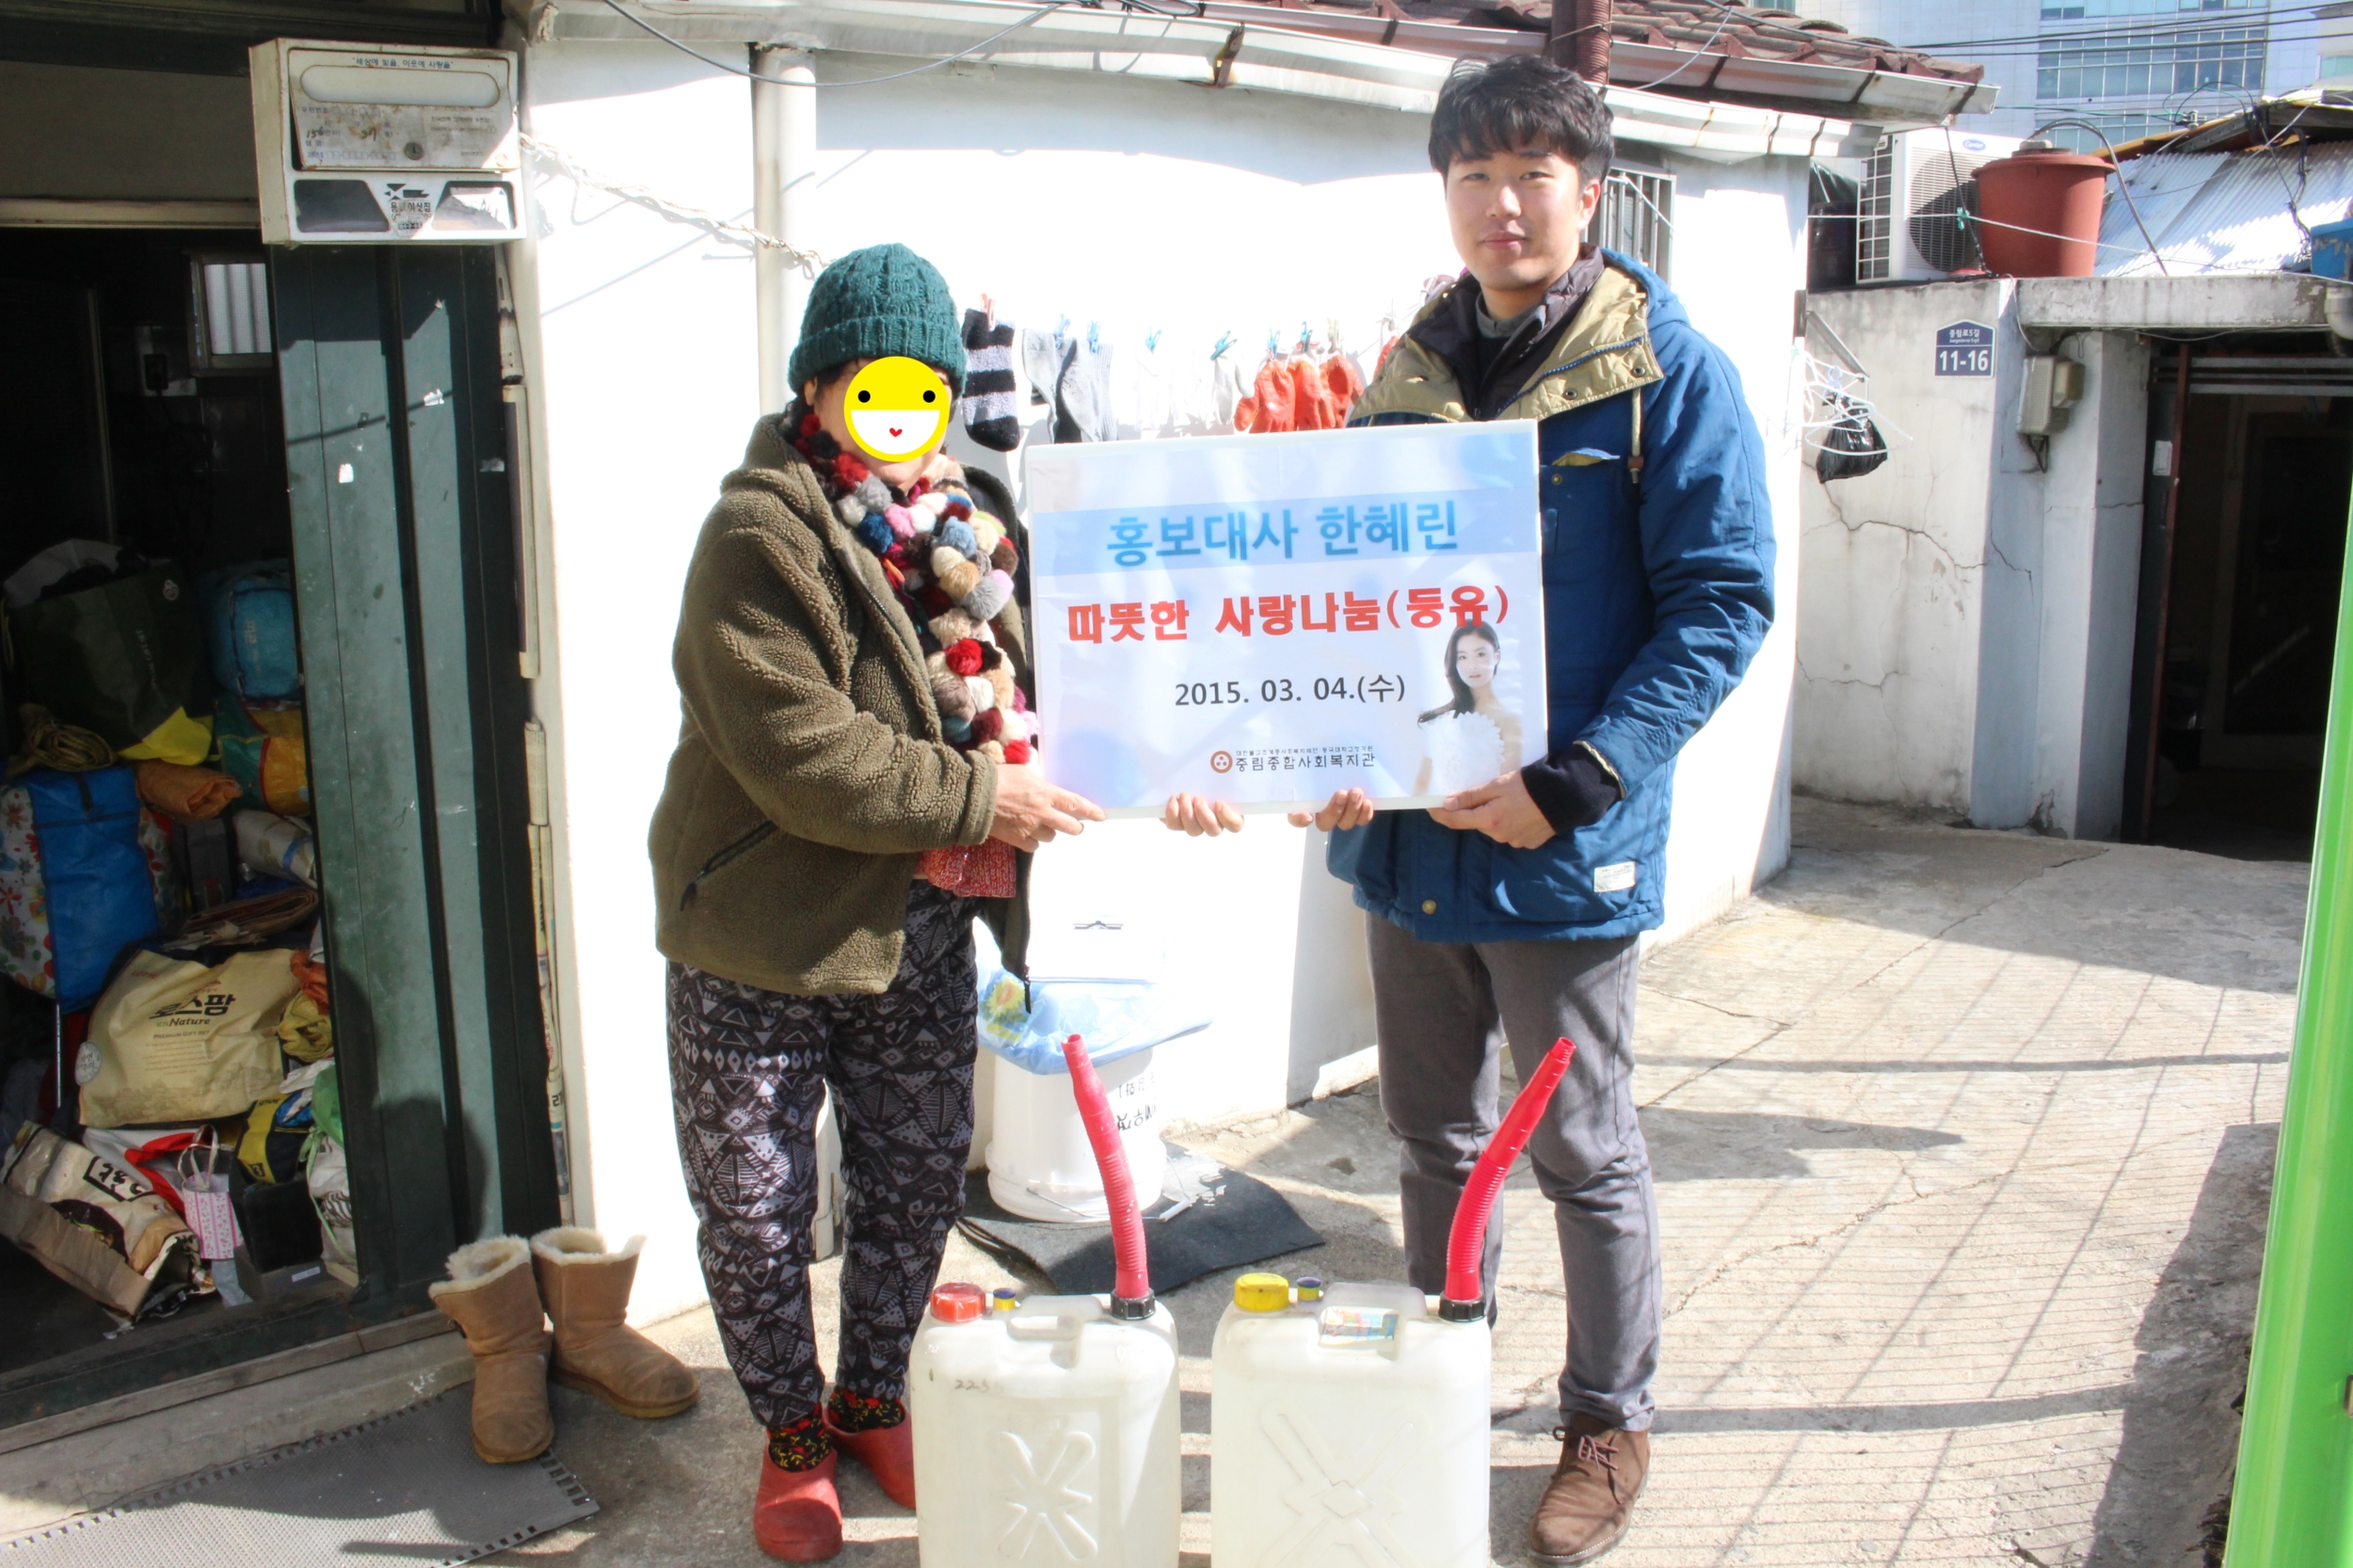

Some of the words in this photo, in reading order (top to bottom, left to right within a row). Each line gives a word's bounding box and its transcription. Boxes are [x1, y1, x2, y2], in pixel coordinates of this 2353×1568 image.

[1939, 349, 1989, 372] 11-16
[1107, 508, 1299, 567] 홍보대사
[1315, 500, 1459, 556] 한혜린
[1067, 599, 1190, 645] 따뜻한
[1215, 585, 1509, 637] 사랑나눔(등유)
[1174, 681, 1249, 707] 2015.
[1260, 679, 1302, 703] 03.
[1314, 674, 1406, 705] 04.(수)
[1235, 753, 1375, 773] 중림종합사회복지관
[150, 994, 236, 1019] 로스팜
